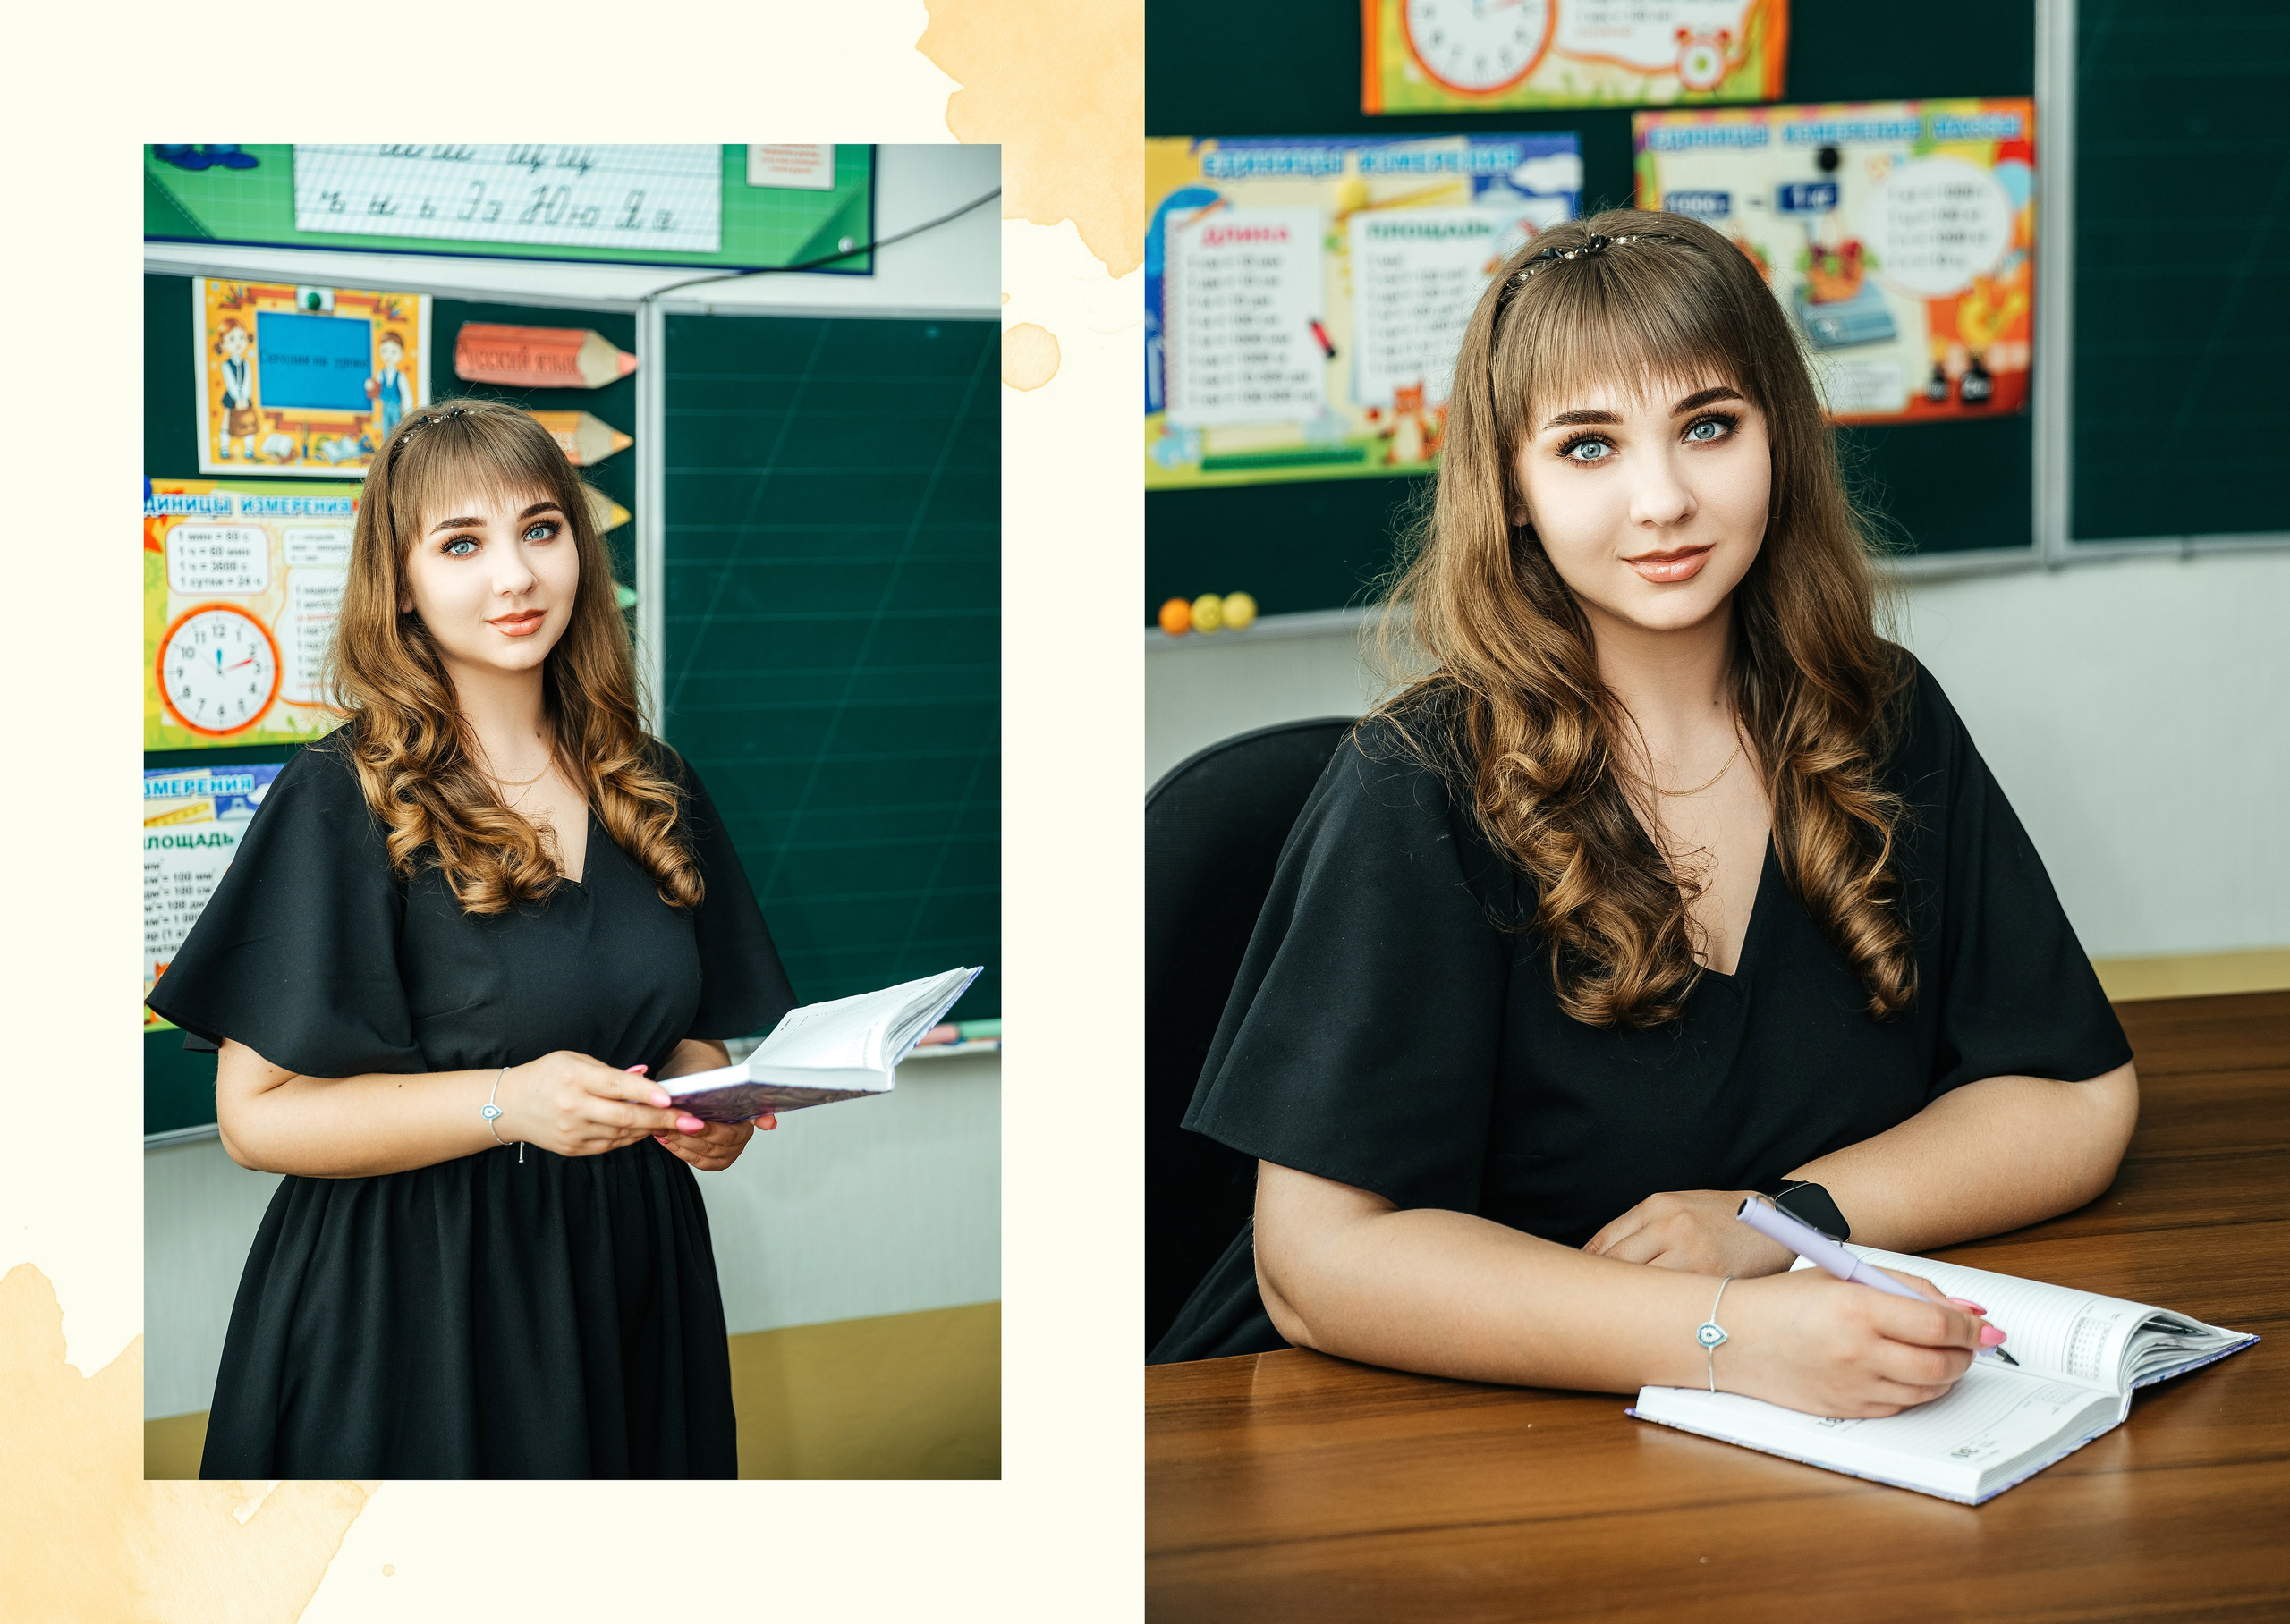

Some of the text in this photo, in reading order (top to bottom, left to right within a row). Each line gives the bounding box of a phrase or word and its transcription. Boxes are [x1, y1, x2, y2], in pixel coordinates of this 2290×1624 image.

[241, 496, 352, 516] ИЗМЕРЕНИЯ
[195, 631, 206, 644] 11
[212, 624, 225, 638] 12
[236, 630, 242, 642] 1
[182, 646, 195, 660] 10
[249, 643, 256, 656] 2
[176, 667, 183, 680] 9
[254, 662, 261, 675] 3
[182, 685, 191, 698] 8
[249, 682, 256, 694] 4
[199, 697, 205, 710] 7
[218, 703, 225, 716] 6
[238, 698, 245, 712] 5
[144, 833, 234, 849] ЛОЩАДЬ
